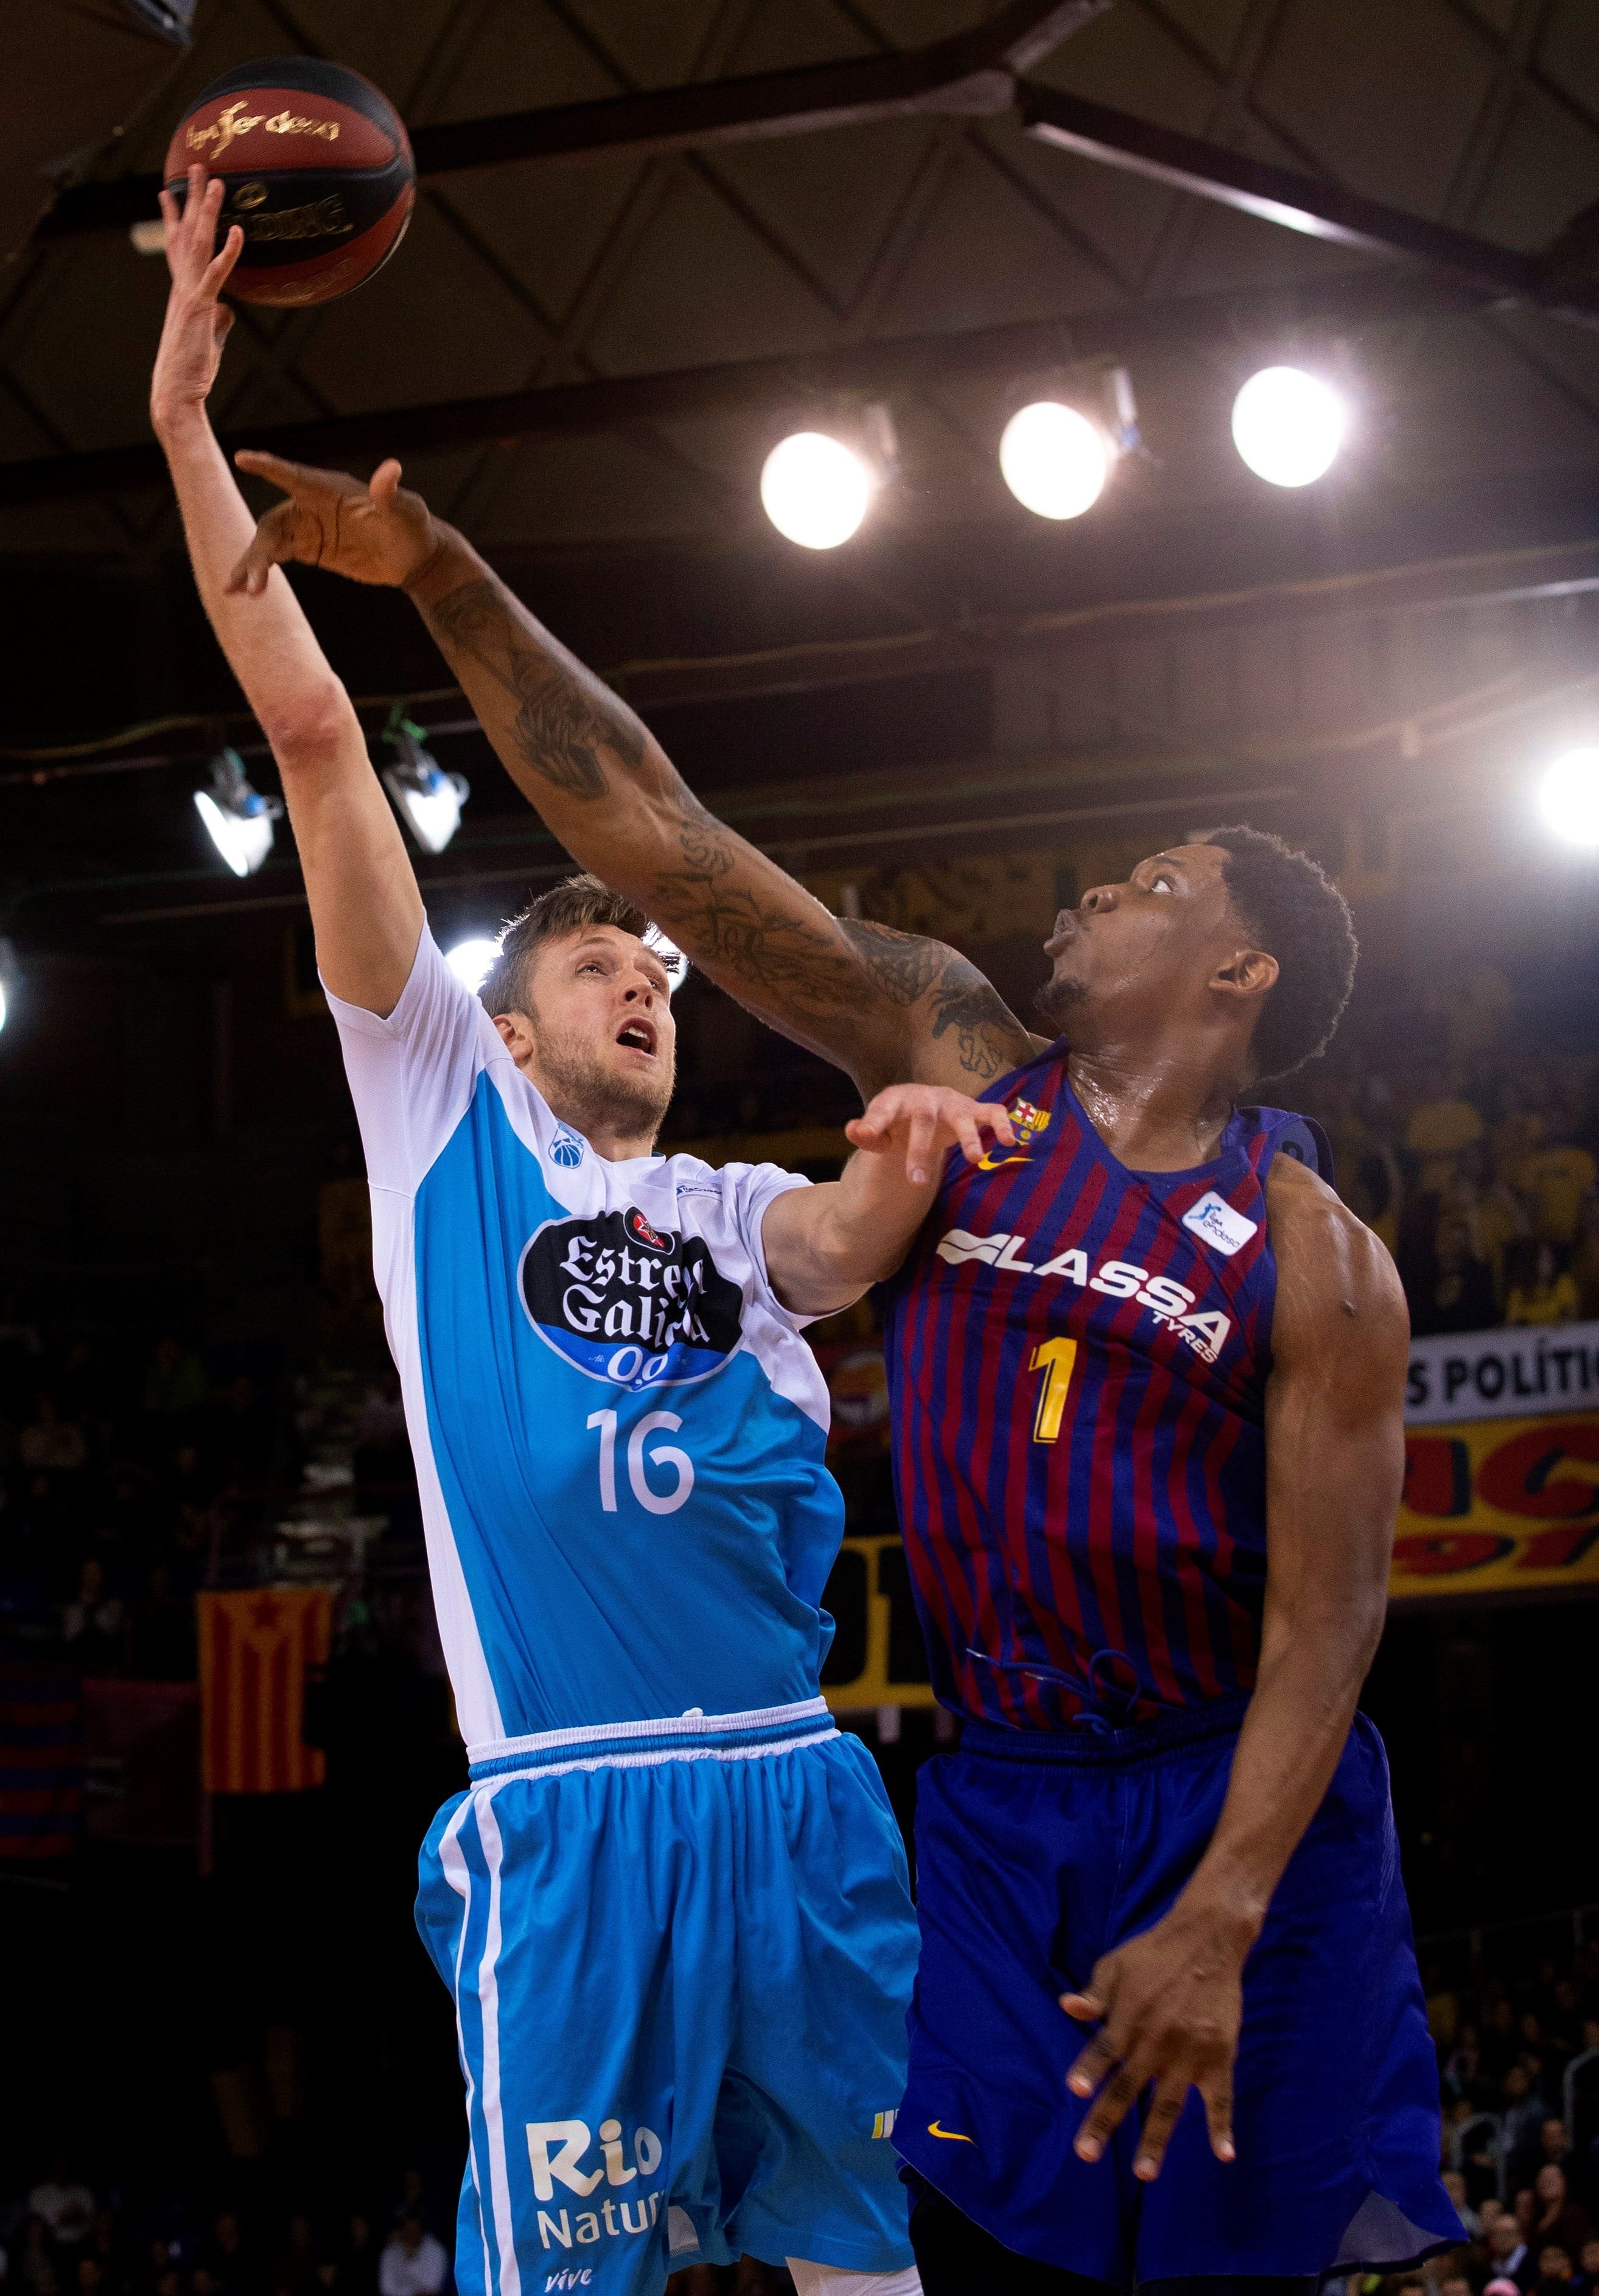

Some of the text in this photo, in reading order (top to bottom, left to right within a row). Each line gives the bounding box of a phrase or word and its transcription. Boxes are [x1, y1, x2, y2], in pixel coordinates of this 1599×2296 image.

[1152, 1309, 1218, 1363] TYRES
[1446, 1338, 1599, 1399] POLÍTI
[1029, 1336, 1077, 1443] 1
[587, 1408, 694, 1514] 16
[525, 2118, 662, 2201] Rio
[537, 2188, 665, 2250] Natur
